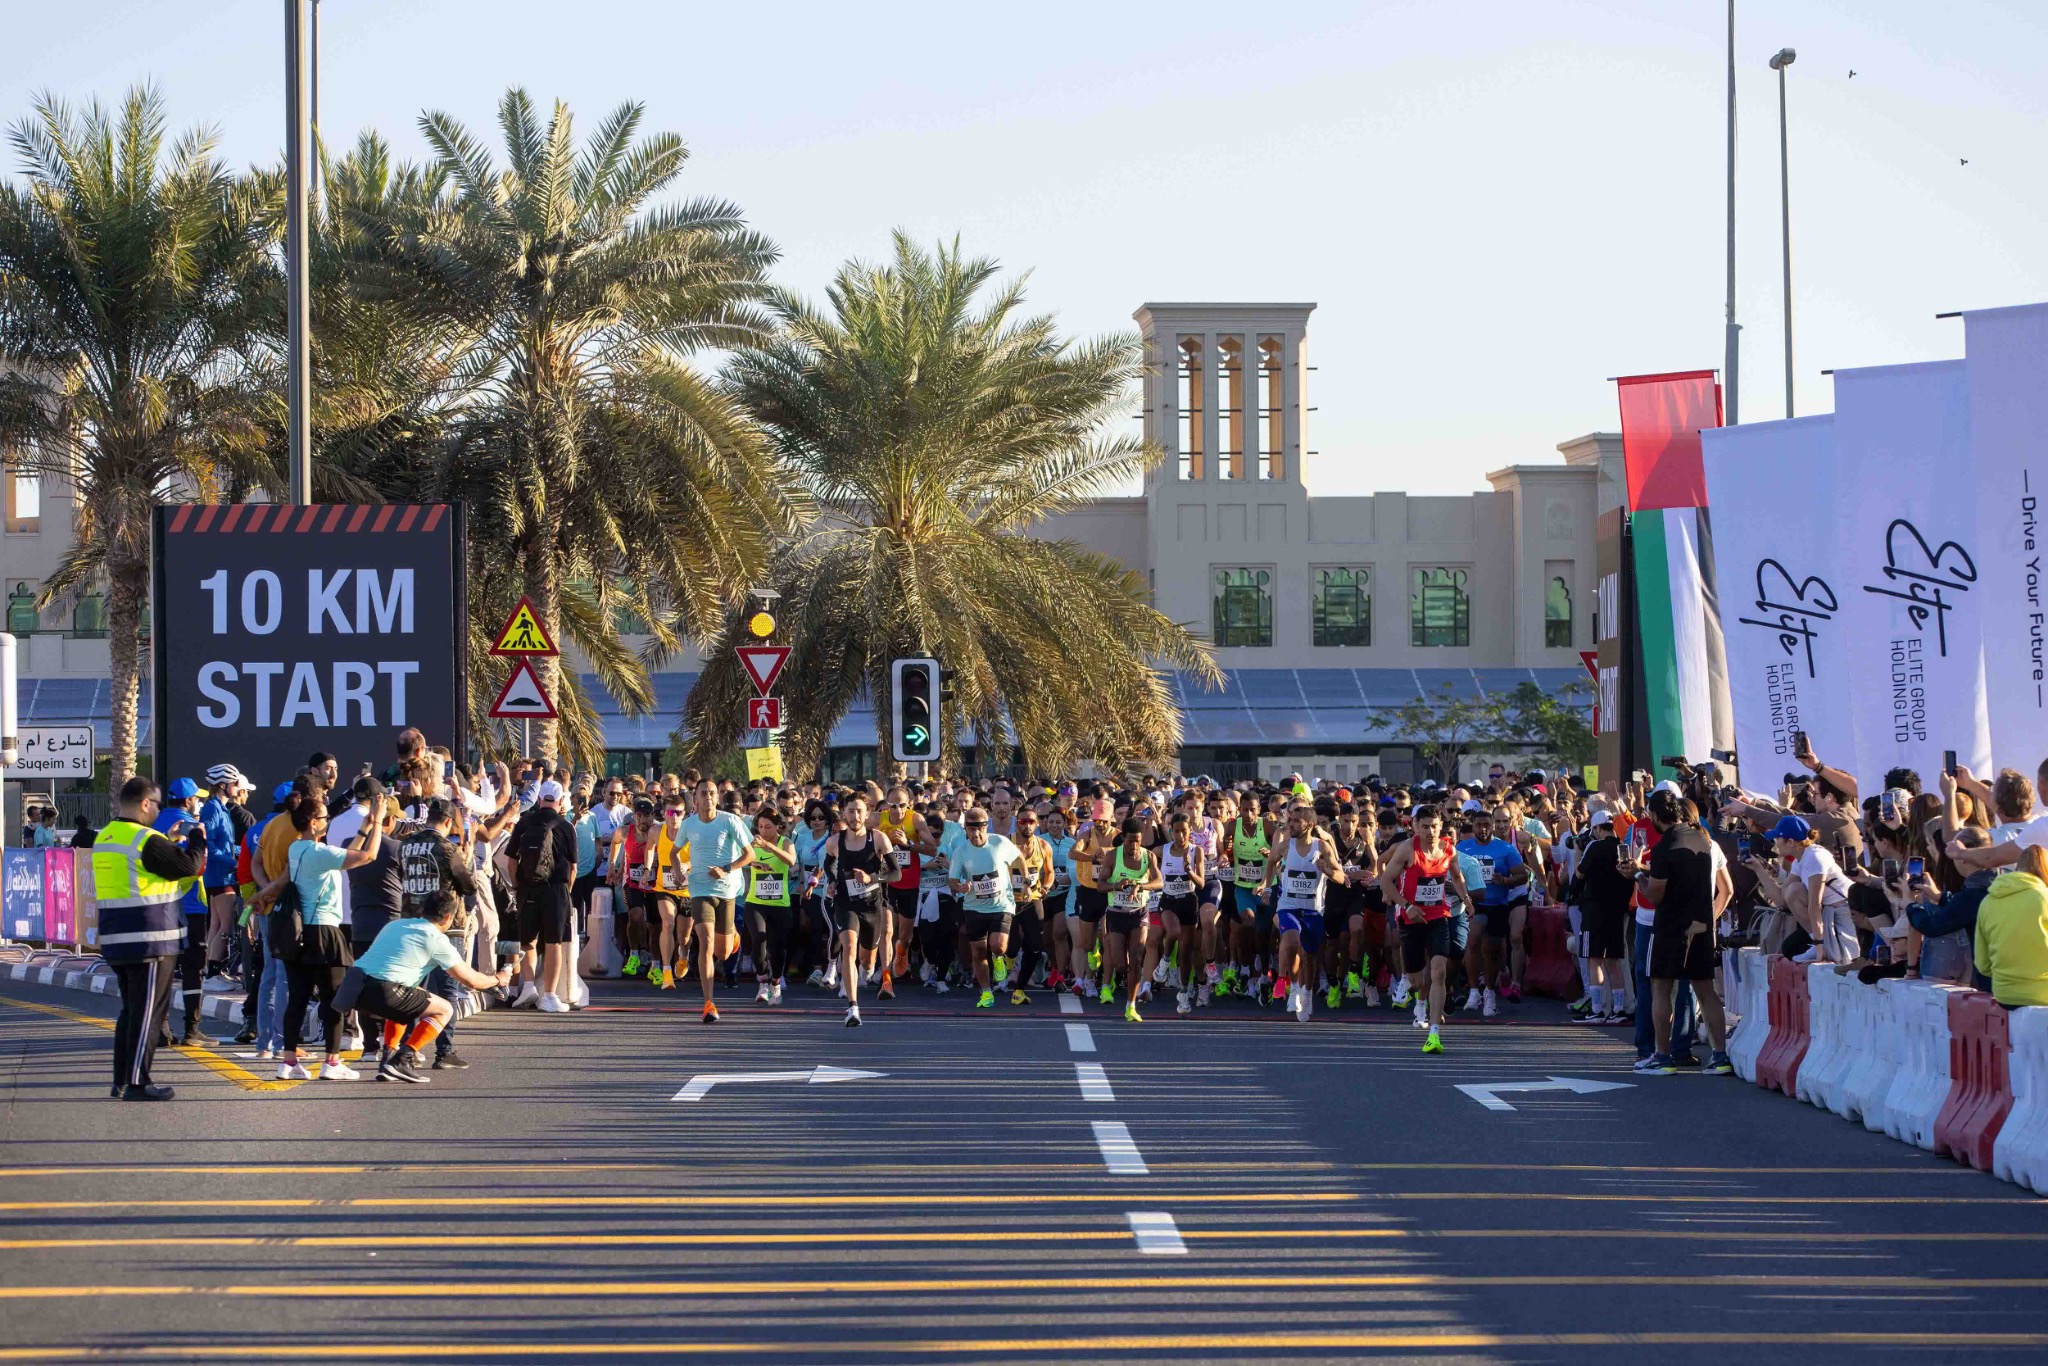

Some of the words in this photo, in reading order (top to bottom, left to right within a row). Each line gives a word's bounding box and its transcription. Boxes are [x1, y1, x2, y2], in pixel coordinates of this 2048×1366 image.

[2021, 497, 2037, 550] Drive
[200, 569, 282, 635] 10
[308, 568, 415, 634] KM
[2025, 556, 2041, 607] Your
[1908, 638, 1924, 683] ELITE
[2029, 613, 2044, 681] Future
[197, 661, 419, 729] START
[1766, 664, 1784, 726] HOLDING
[1781, 663, 1797, 702] ELITE
[1890, 640, 1908, 712] HOLDING
[1600, 666, 1618, 733] START
[1910, 688, 1927, 742] GROUP
[26, 731, 41, 753] أم
[47, 734, 88, 752] شارع
[1773, 728, 1787, 755] LTD
[1894, 714, 1909, 743] LTD
[17, 757, 65, 771] Suqeim
[72, 757, 88, 769] St
[409, 864, 427, 875] NOT
[760, 882, 779, 891] 13010
[1292, 880, 1312, 889] 13182
